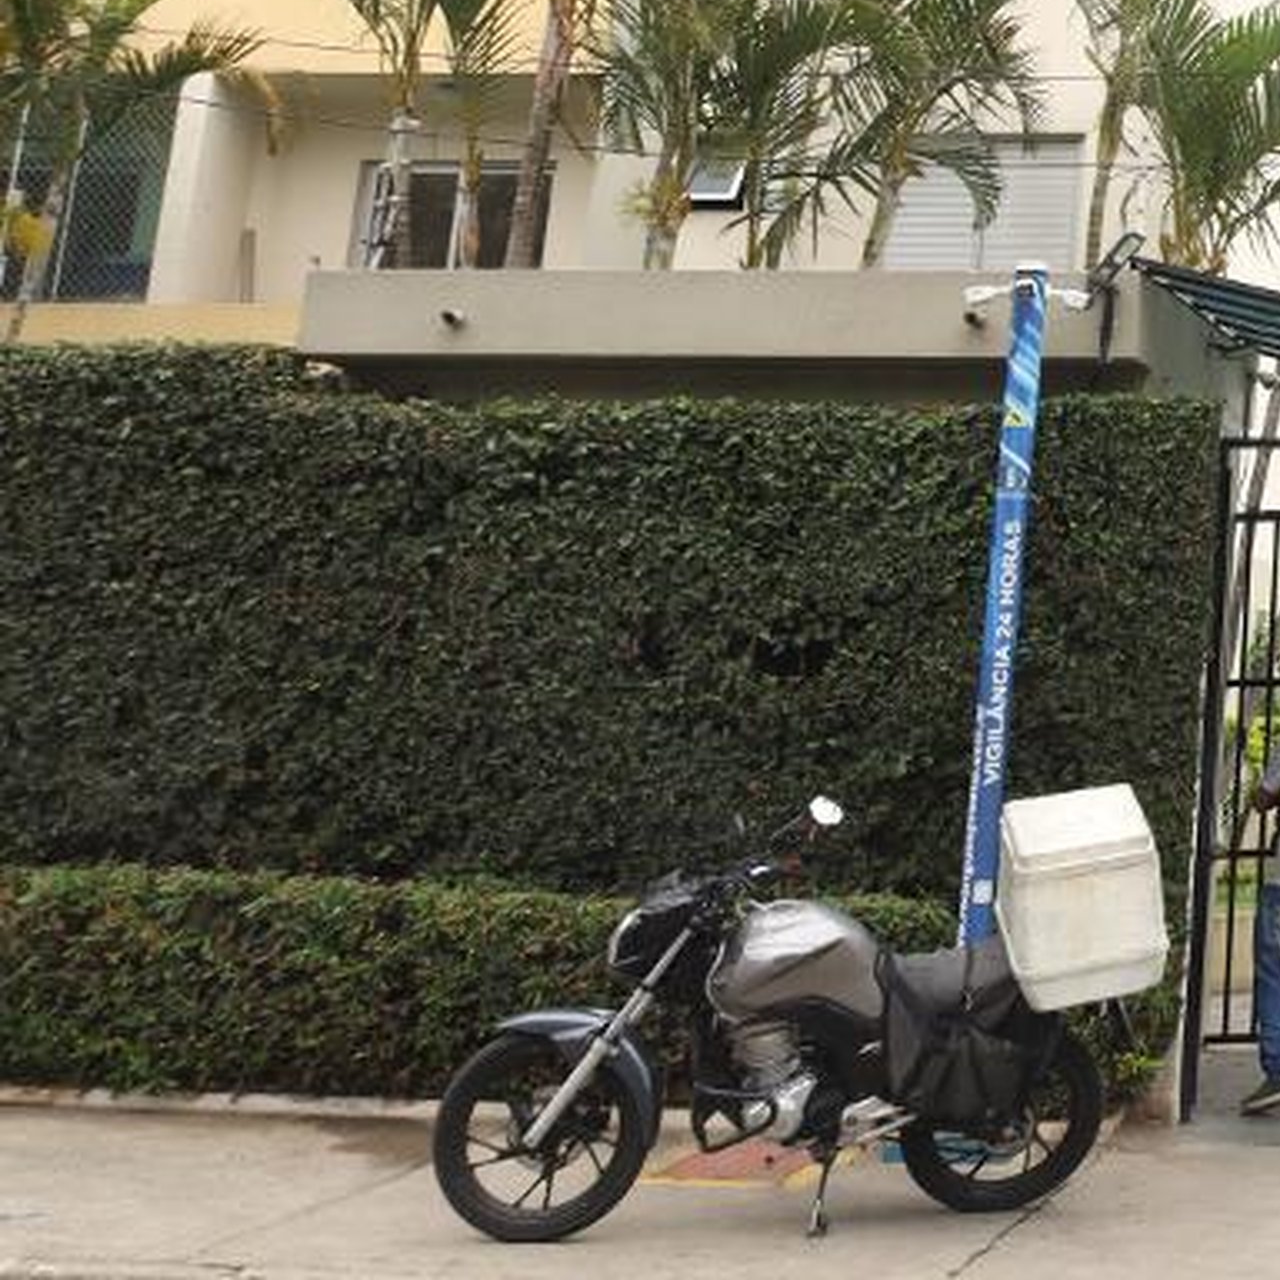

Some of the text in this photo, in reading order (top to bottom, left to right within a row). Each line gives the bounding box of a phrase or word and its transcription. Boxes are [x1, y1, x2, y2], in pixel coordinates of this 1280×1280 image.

[982, 521, 1021, 786] VIGILÂNCIA 24 HORAS
